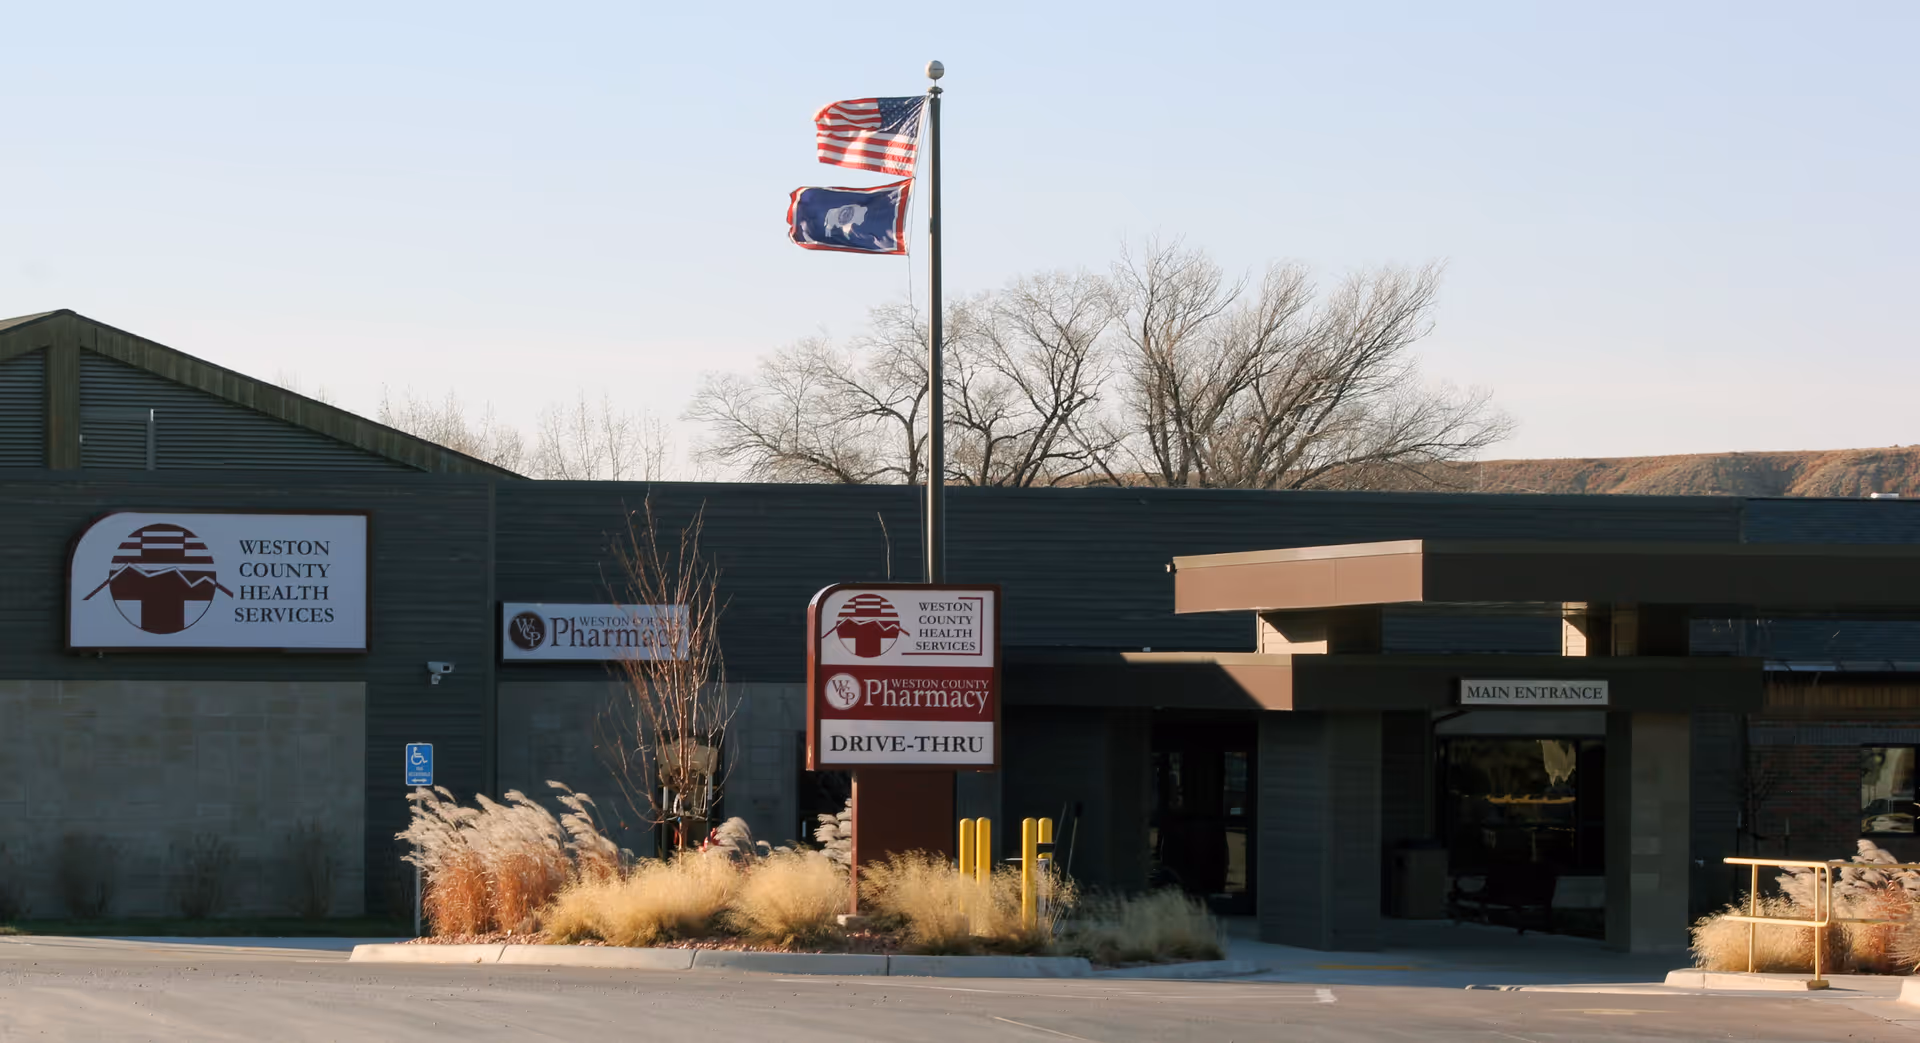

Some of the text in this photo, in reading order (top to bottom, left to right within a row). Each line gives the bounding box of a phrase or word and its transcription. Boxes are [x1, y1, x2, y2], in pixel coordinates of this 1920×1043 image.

[239, 539, 331, 556] WESTON
[239, 562, 331, 578] COUNTY
[240, 585, 329, 600] HEALTH
[918, 602, 974, 612] WESTON
[234, 607, 335, 622] SERVICES
[579, 616, 630, 627] WESTON
[918, 615, 973, 625] COUNTY
[919, 628, 973, 638] HEALTH
[915, 641, 976, 651] SERVICES
[891, 678, 989, 689] WESTON COUNTY
[863, 678, 989, 714] Pharmacy
[1467, 686, 1603, 700] MAIN ENTRANCE
[830, 735, 984, 753] DRIVE-THRU
